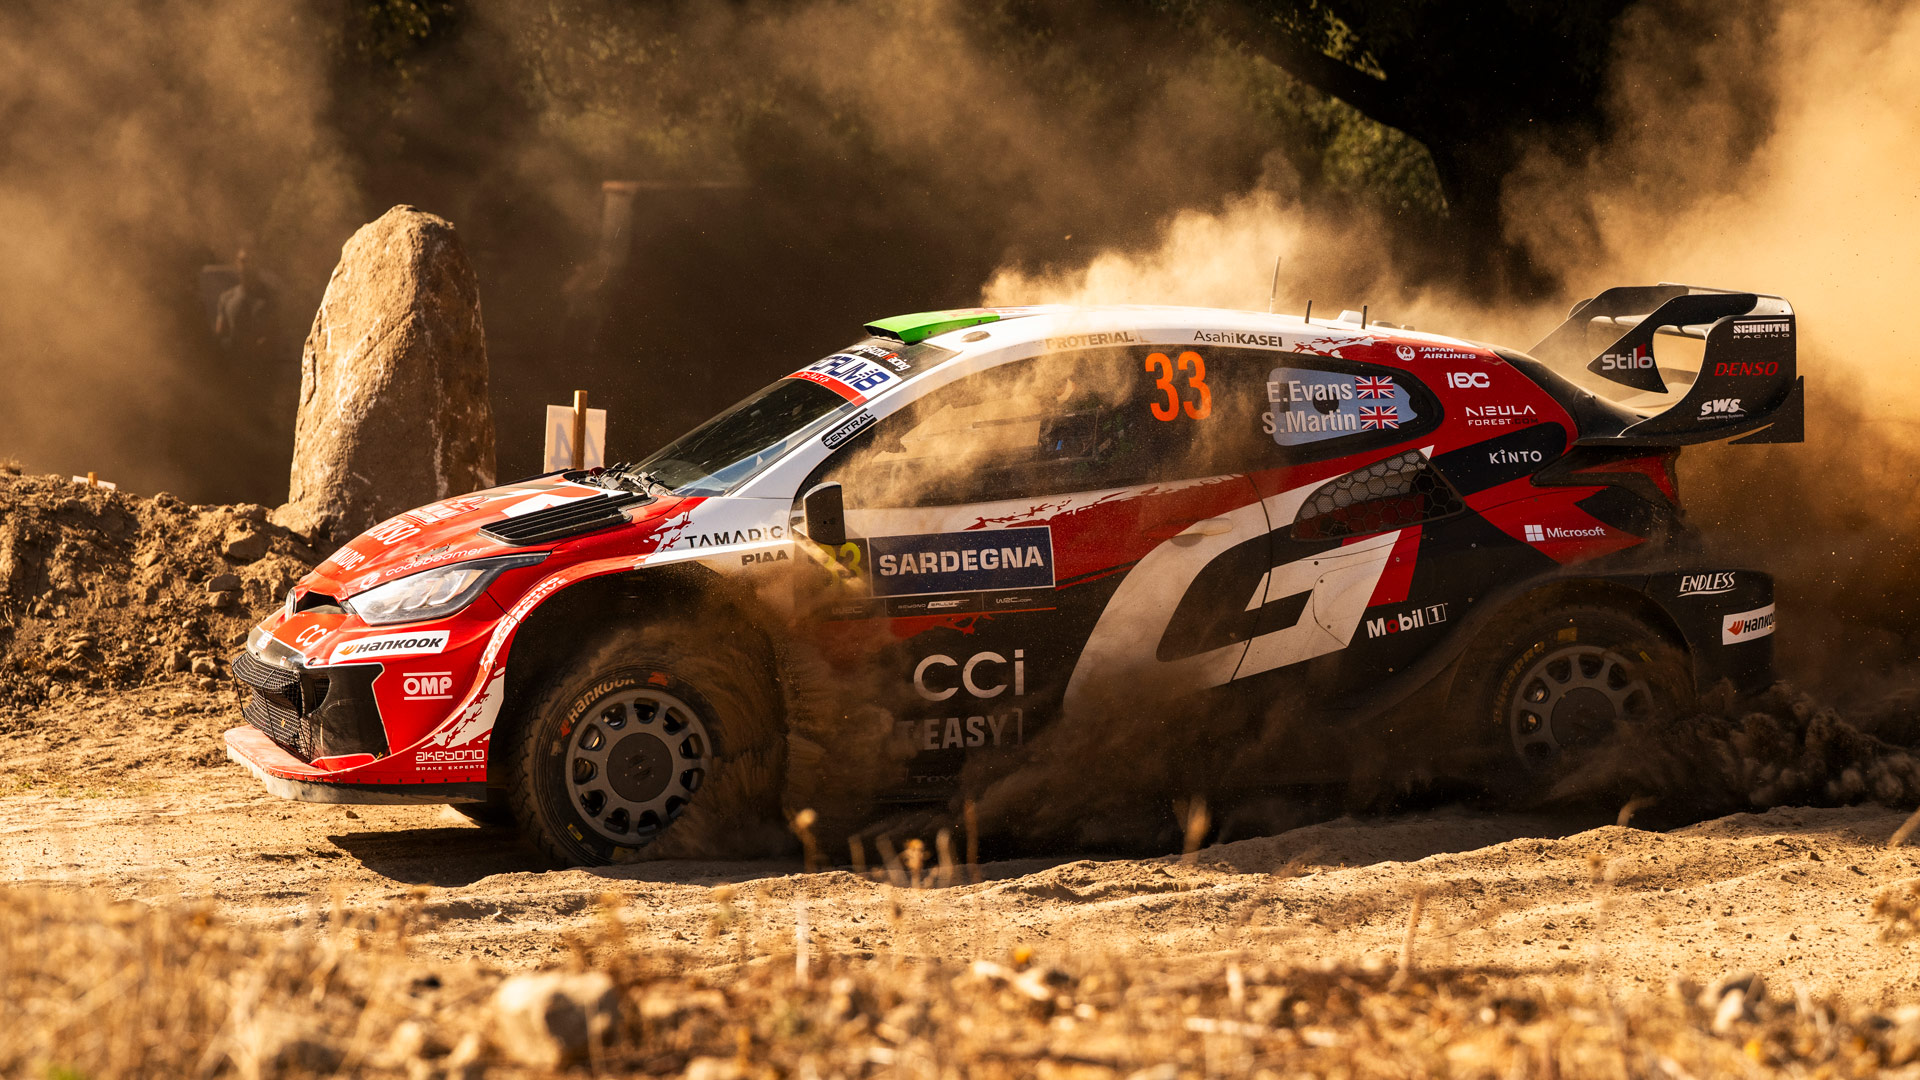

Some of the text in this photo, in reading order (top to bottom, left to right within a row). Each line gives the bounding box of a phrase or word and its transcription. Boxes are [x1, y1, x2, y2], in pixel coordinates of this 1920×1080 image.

[1733, 323, 1790, 334] SCHROTH
[1602, 347, 1654, 370] Stilo
[1713, 361, 1779, 377] DENSO
[1144, 350, 1213, 423] 33
[1266, 379, 1354, 404] E.Evans
[1700, 398, 1745, 416] SWS
[823, 411, 874, 448] CENTRAL
[1261, 409, 1357, 435] S.Martin
[684, 525, 785, 549] TAMADIC
[1546, 525, 1607, 539] Microsoft
[741, 548, 788, 566] PIAA
[878, 545, 1044, 577] SARDEGNA
[1679, 571, 1736, 593] ENDLESS
[1366, 608, 1425, 639] Mobil
[403, 676, 453, 696] OMP
